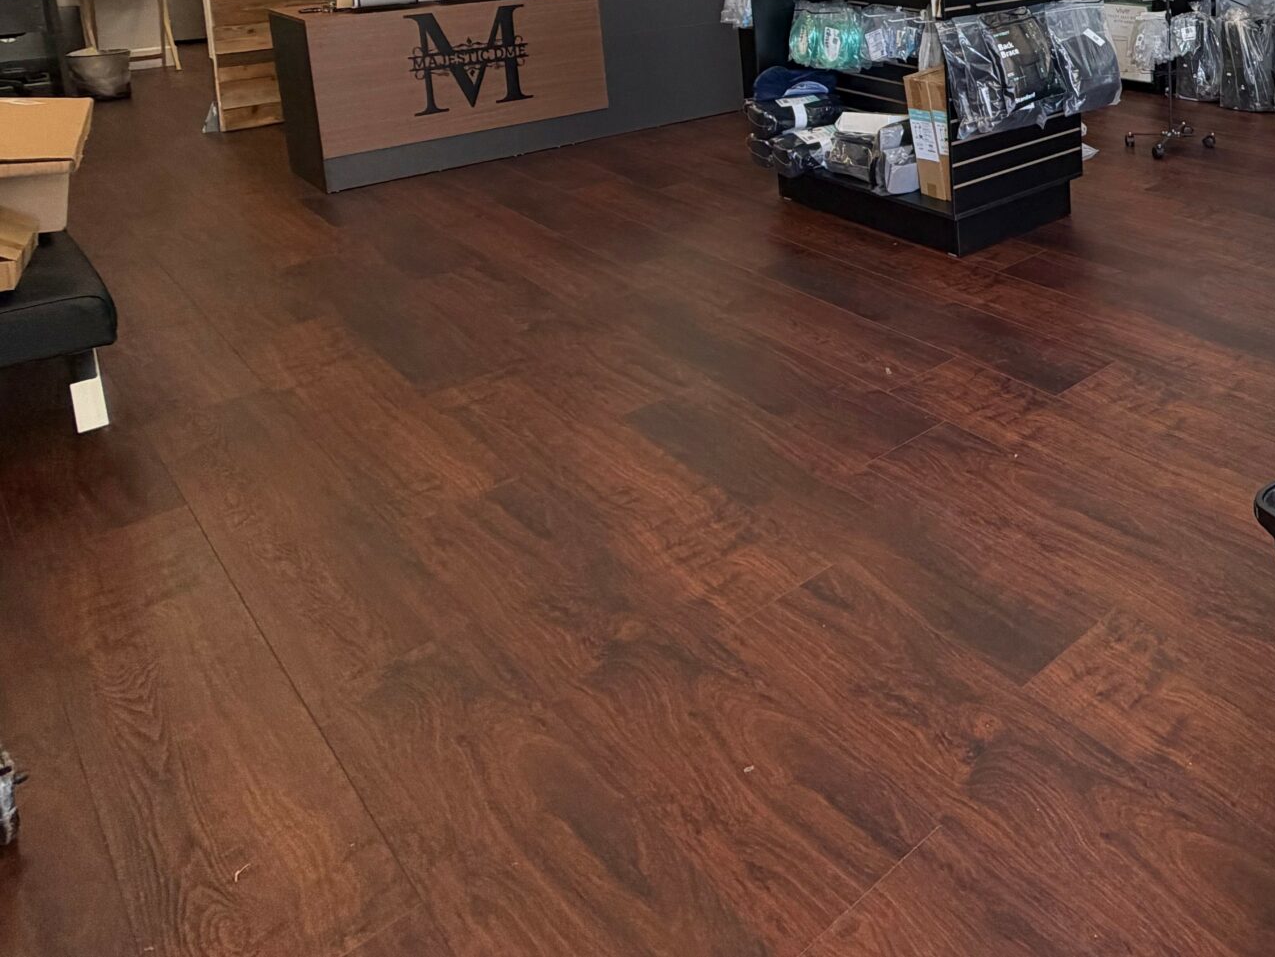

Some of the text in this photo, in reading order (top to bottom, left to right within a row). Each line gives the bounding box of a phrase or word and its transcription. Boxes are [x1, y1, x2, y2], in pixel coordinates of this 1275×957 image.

[997, 41, 1015, 51] Back
[1000, 48, 1020, 59] Brace
[402, 3, 534, 117] M
[1014, 92, 1036, 104] Standard
